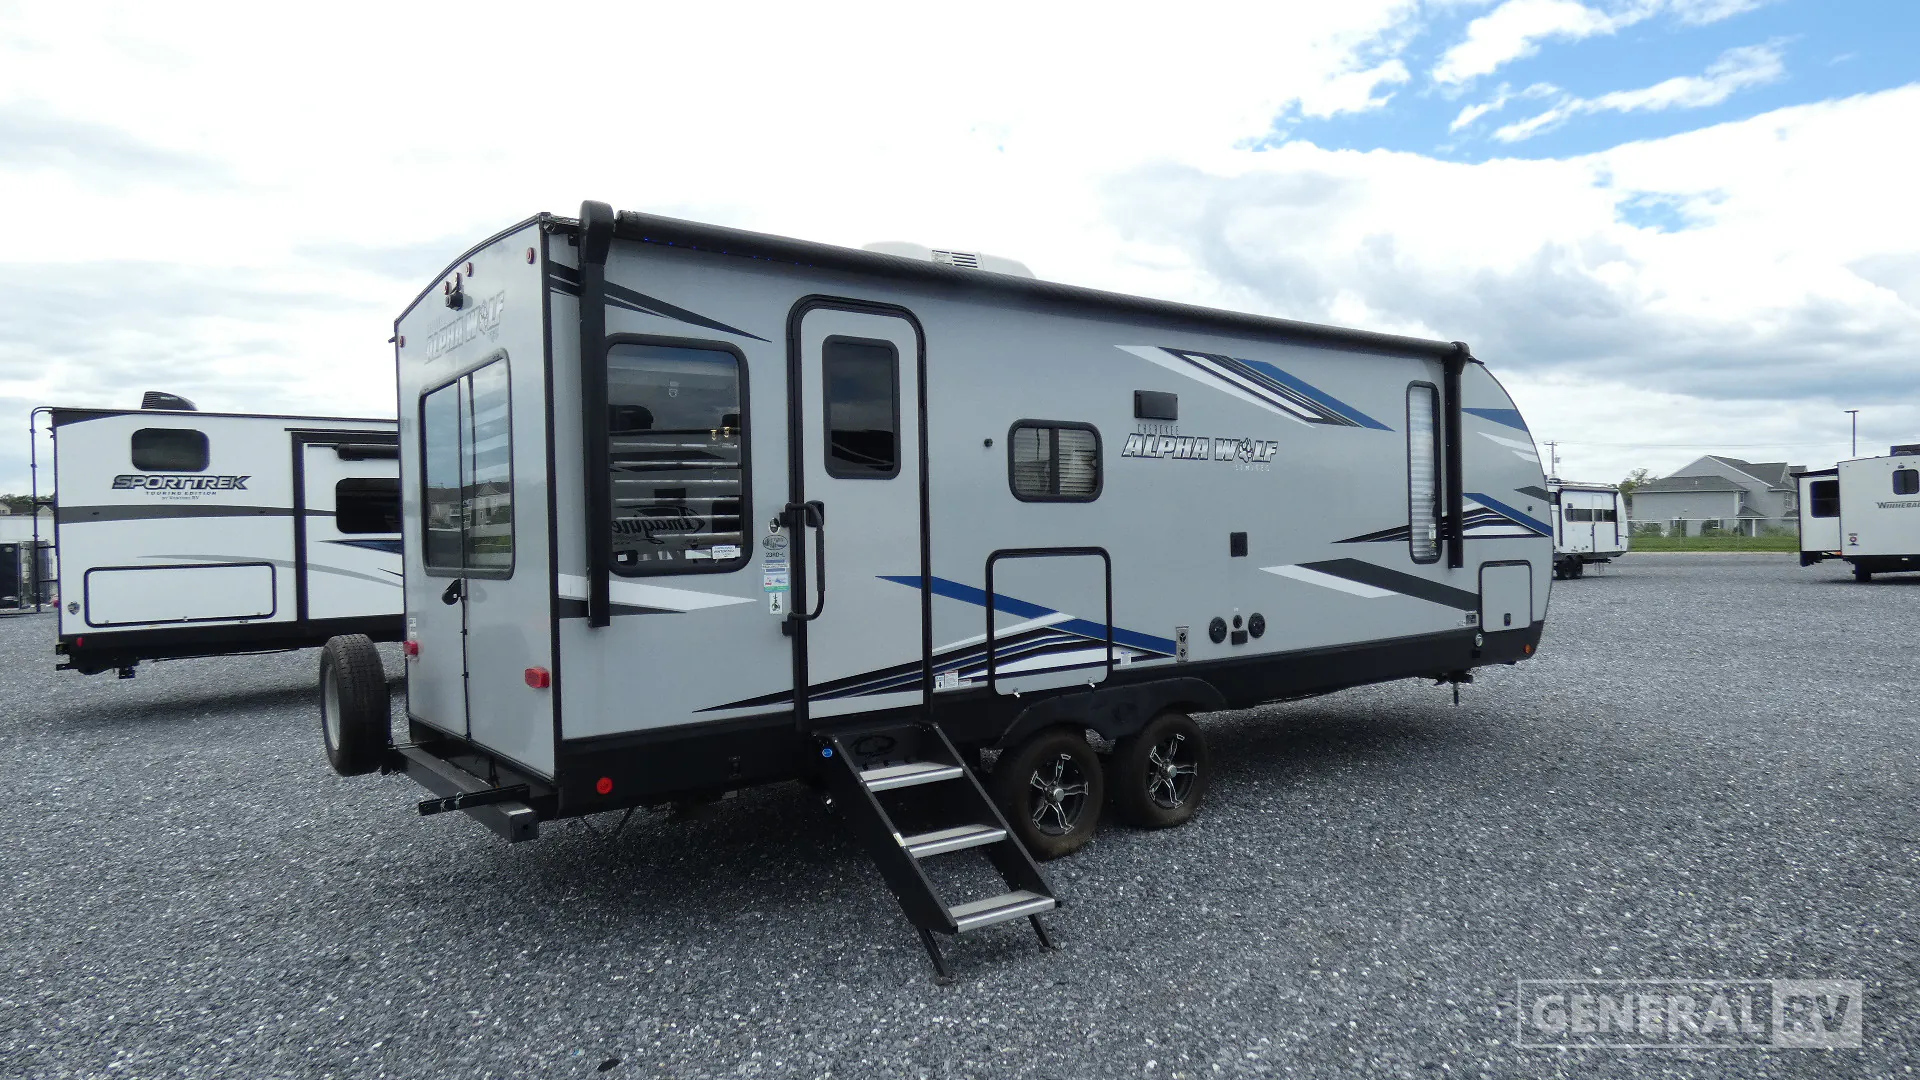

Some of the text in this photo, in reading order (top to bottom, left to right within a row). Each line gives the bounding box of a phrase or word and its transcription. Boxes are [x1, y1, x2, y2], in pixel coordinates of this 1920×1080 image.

[425, 316, 464, 365] ALPHA
[1137, 424, 1180, 436] CHEROKEE
[1121, 433, 1279, 463] ALPHA WOLF
[112, 474, 252, 490] SPORTTREK
